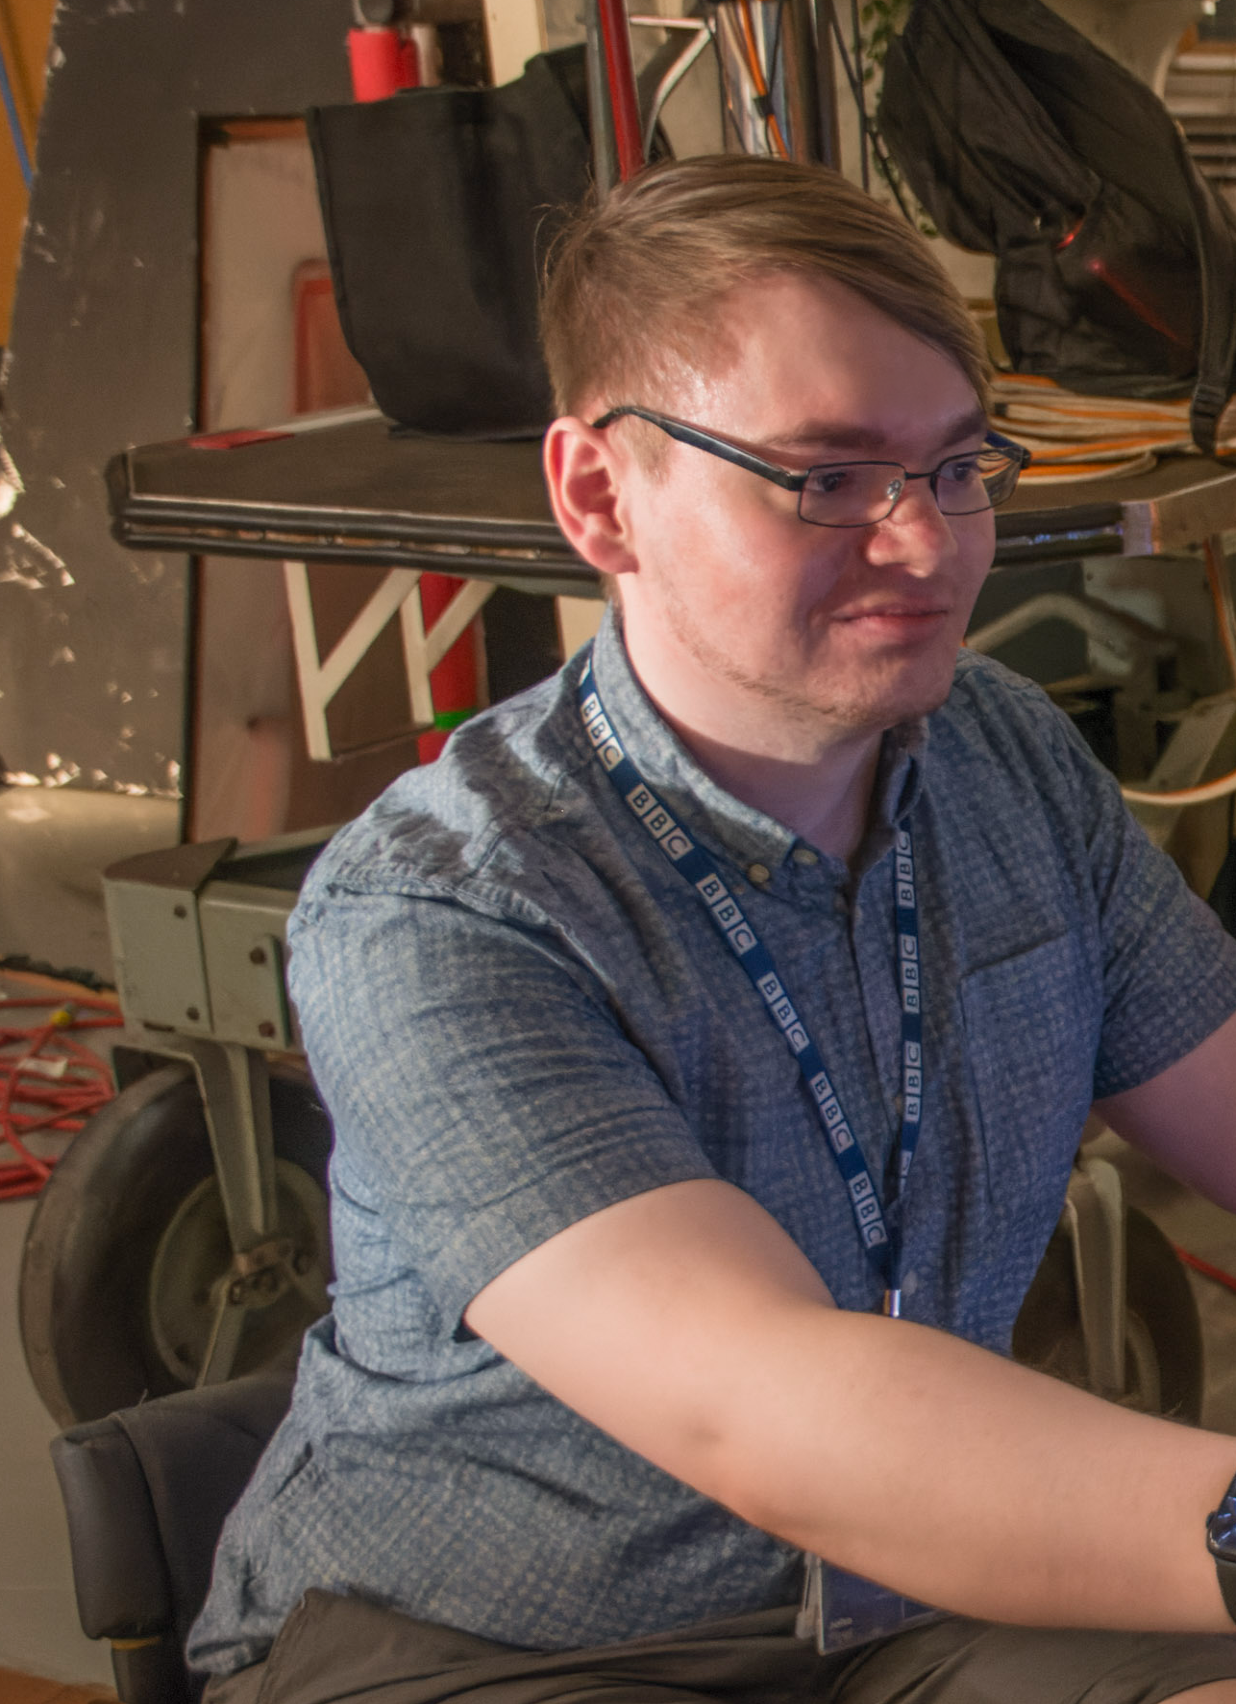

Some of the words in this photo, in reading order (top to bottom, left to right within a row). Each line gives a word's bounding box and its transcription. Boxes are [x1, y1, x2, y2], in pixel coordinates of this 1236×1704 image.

[581, 693, 624, 770] BBC
[627, 784, 694, 860] BBC
[897, 832, 914, 908] BBC
[697, 874, 757, 954] BBC
[757, 972, 809, 1053] BBC
[901, 934, 920, 1013] BBC
[811, 1072, 854, 1154] BBC
[905, 1042, 922, 1122] BBC
[850, 1172, 888, 1249] BBC
